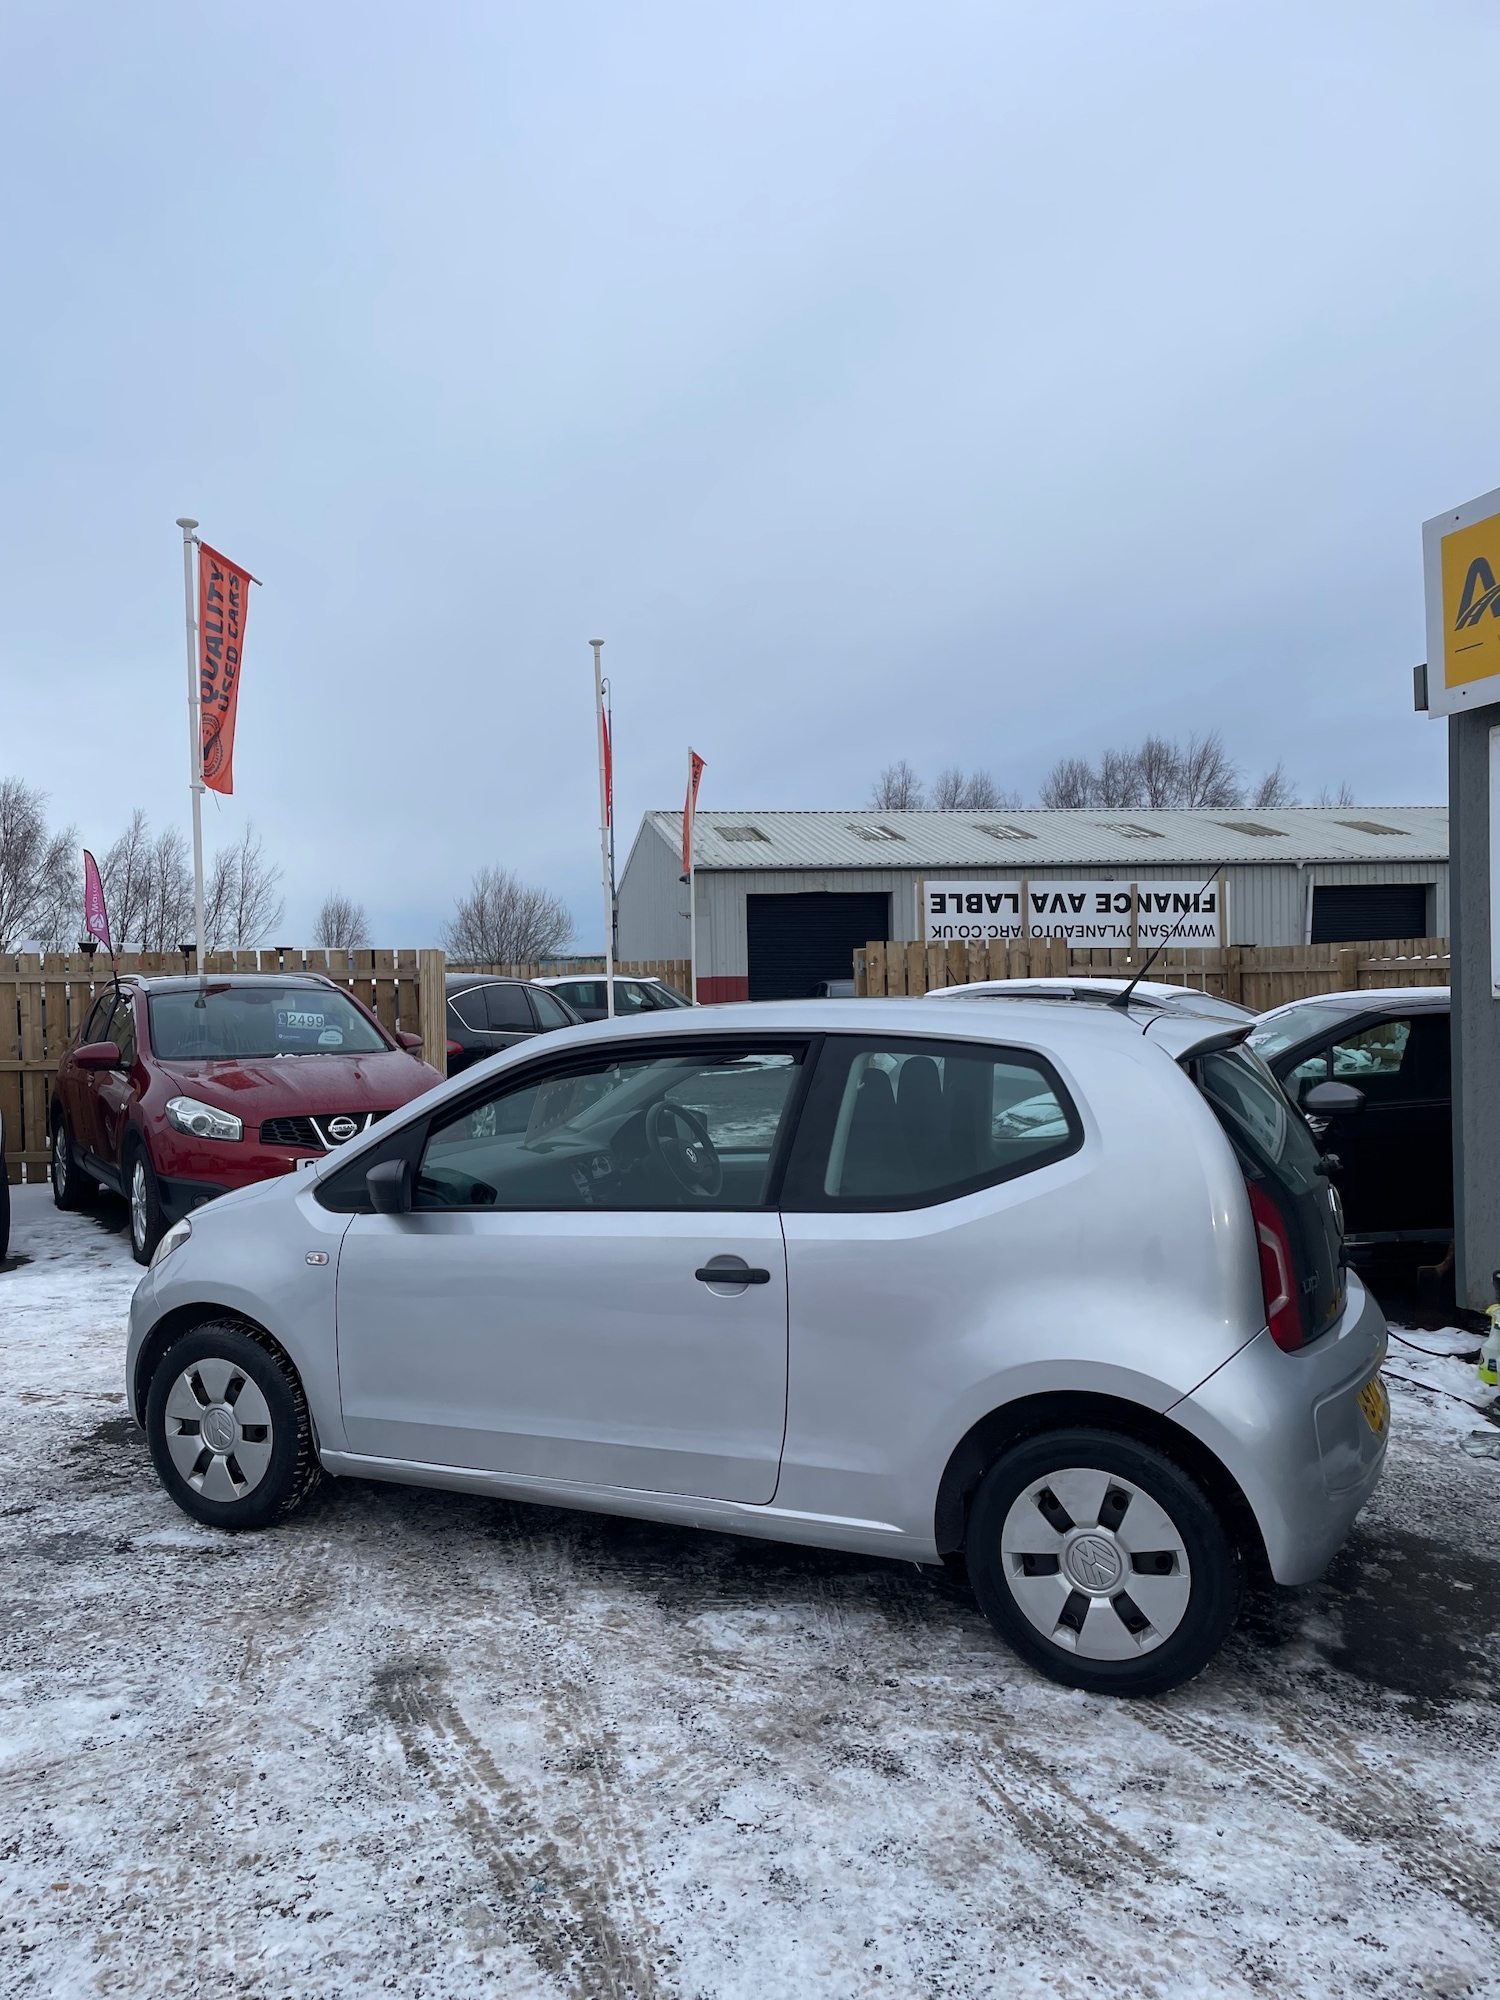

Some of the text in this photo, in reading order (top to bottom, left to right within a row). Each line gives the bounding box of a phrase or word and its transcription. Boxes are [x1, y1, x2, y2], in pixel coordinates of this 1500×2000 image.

[201, 559, 225, 705] QUALITY
[217, 571, 241, 713] USED CARS
[930, 893, 1216, 914] FINANCE AVALABLE
[277, 1012, 325, 1028] £2499
[331, 1124, 356, 1132] NISSAN
